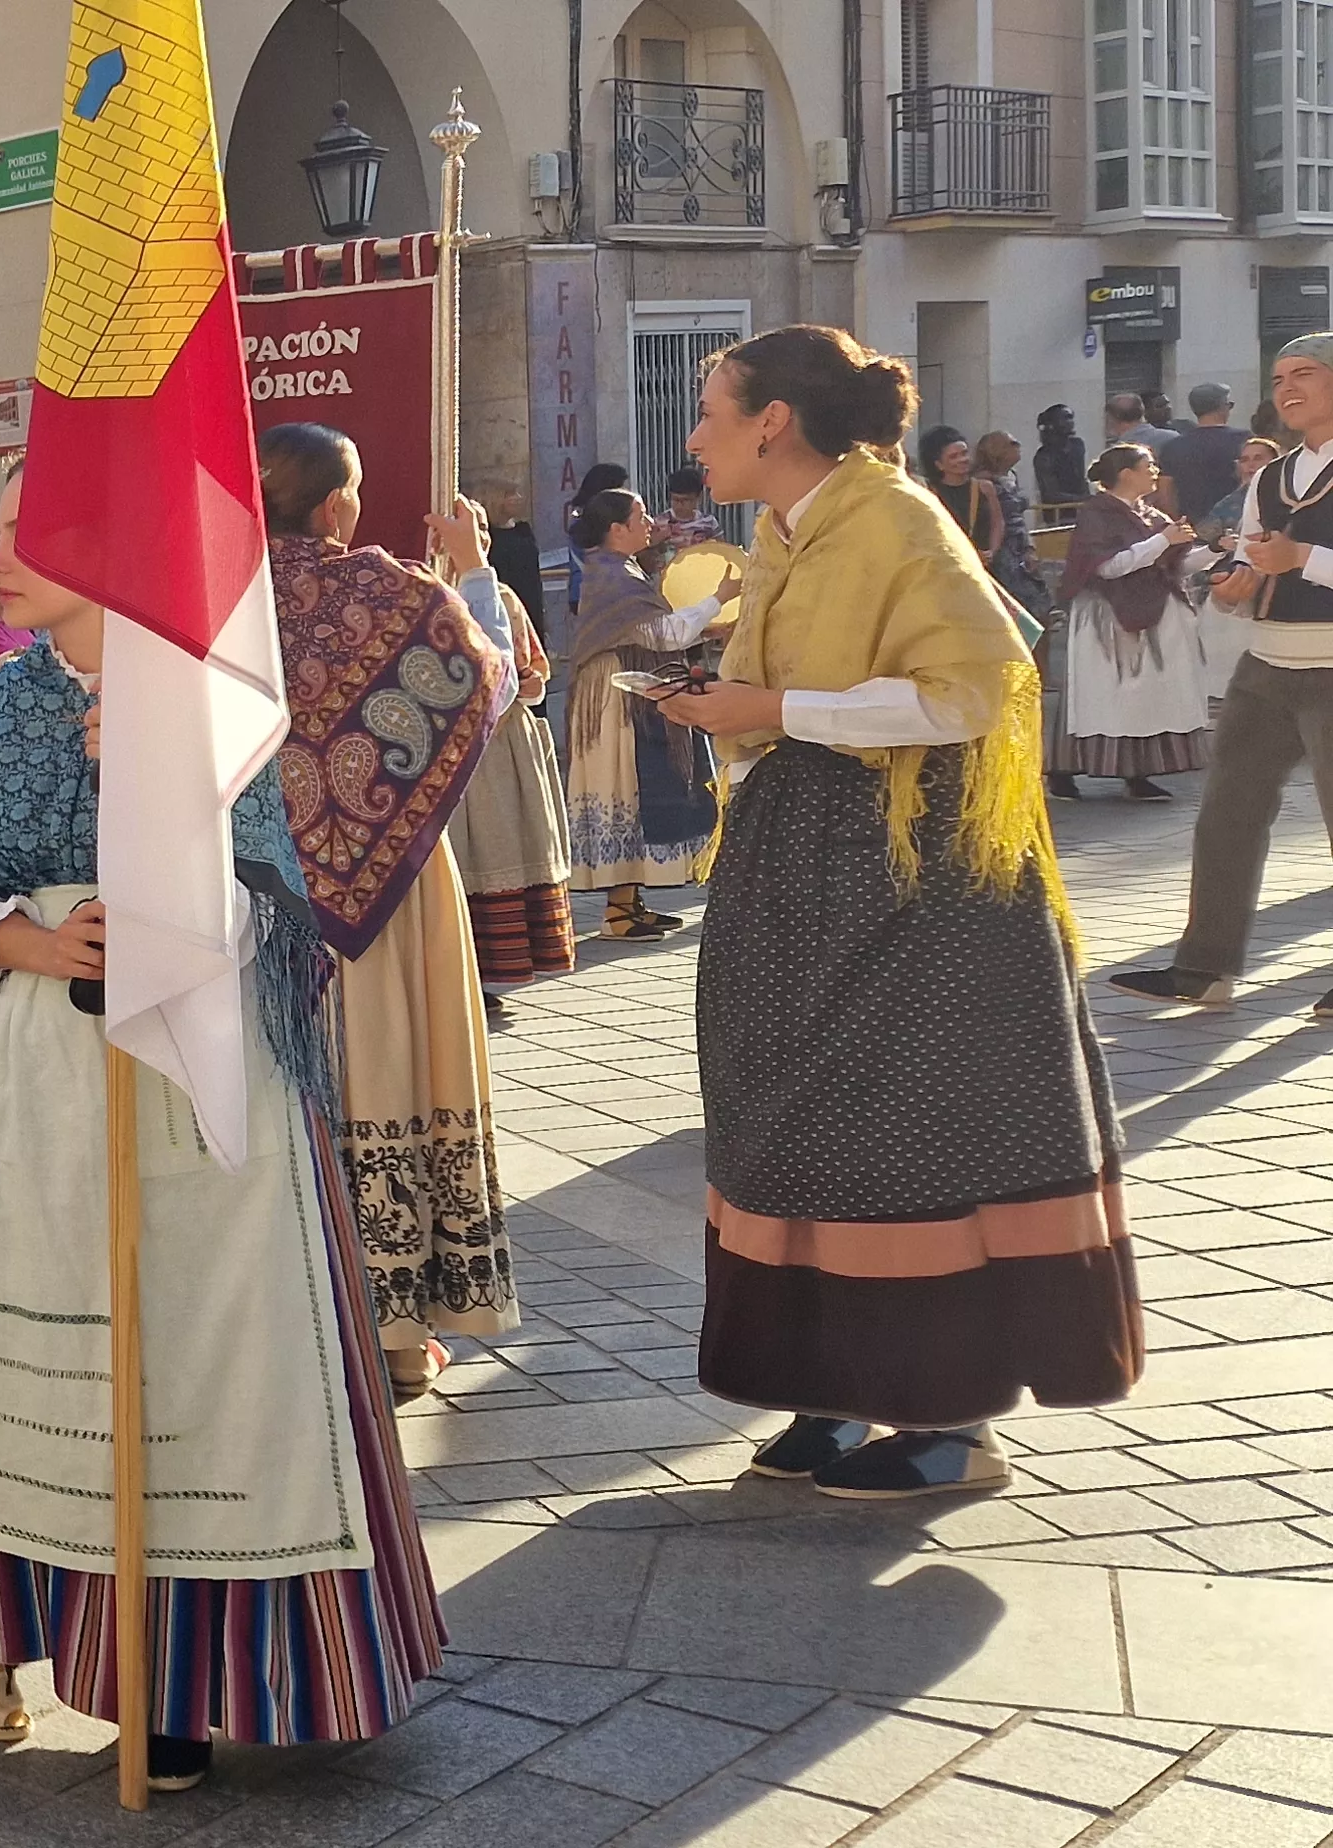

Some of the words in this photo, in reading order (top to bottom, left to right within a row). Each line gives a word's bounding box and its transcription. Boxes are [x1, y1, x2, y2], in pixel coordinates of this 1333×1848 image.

[8, 151, 47, 169] PORCHES
[10, 165, 46, 181] GALICIA
[1089, 282, 1155, 303] embou
[242, 321, 361, 362] PACIÓN
[251, 367, 353, 401] ÓRICA
